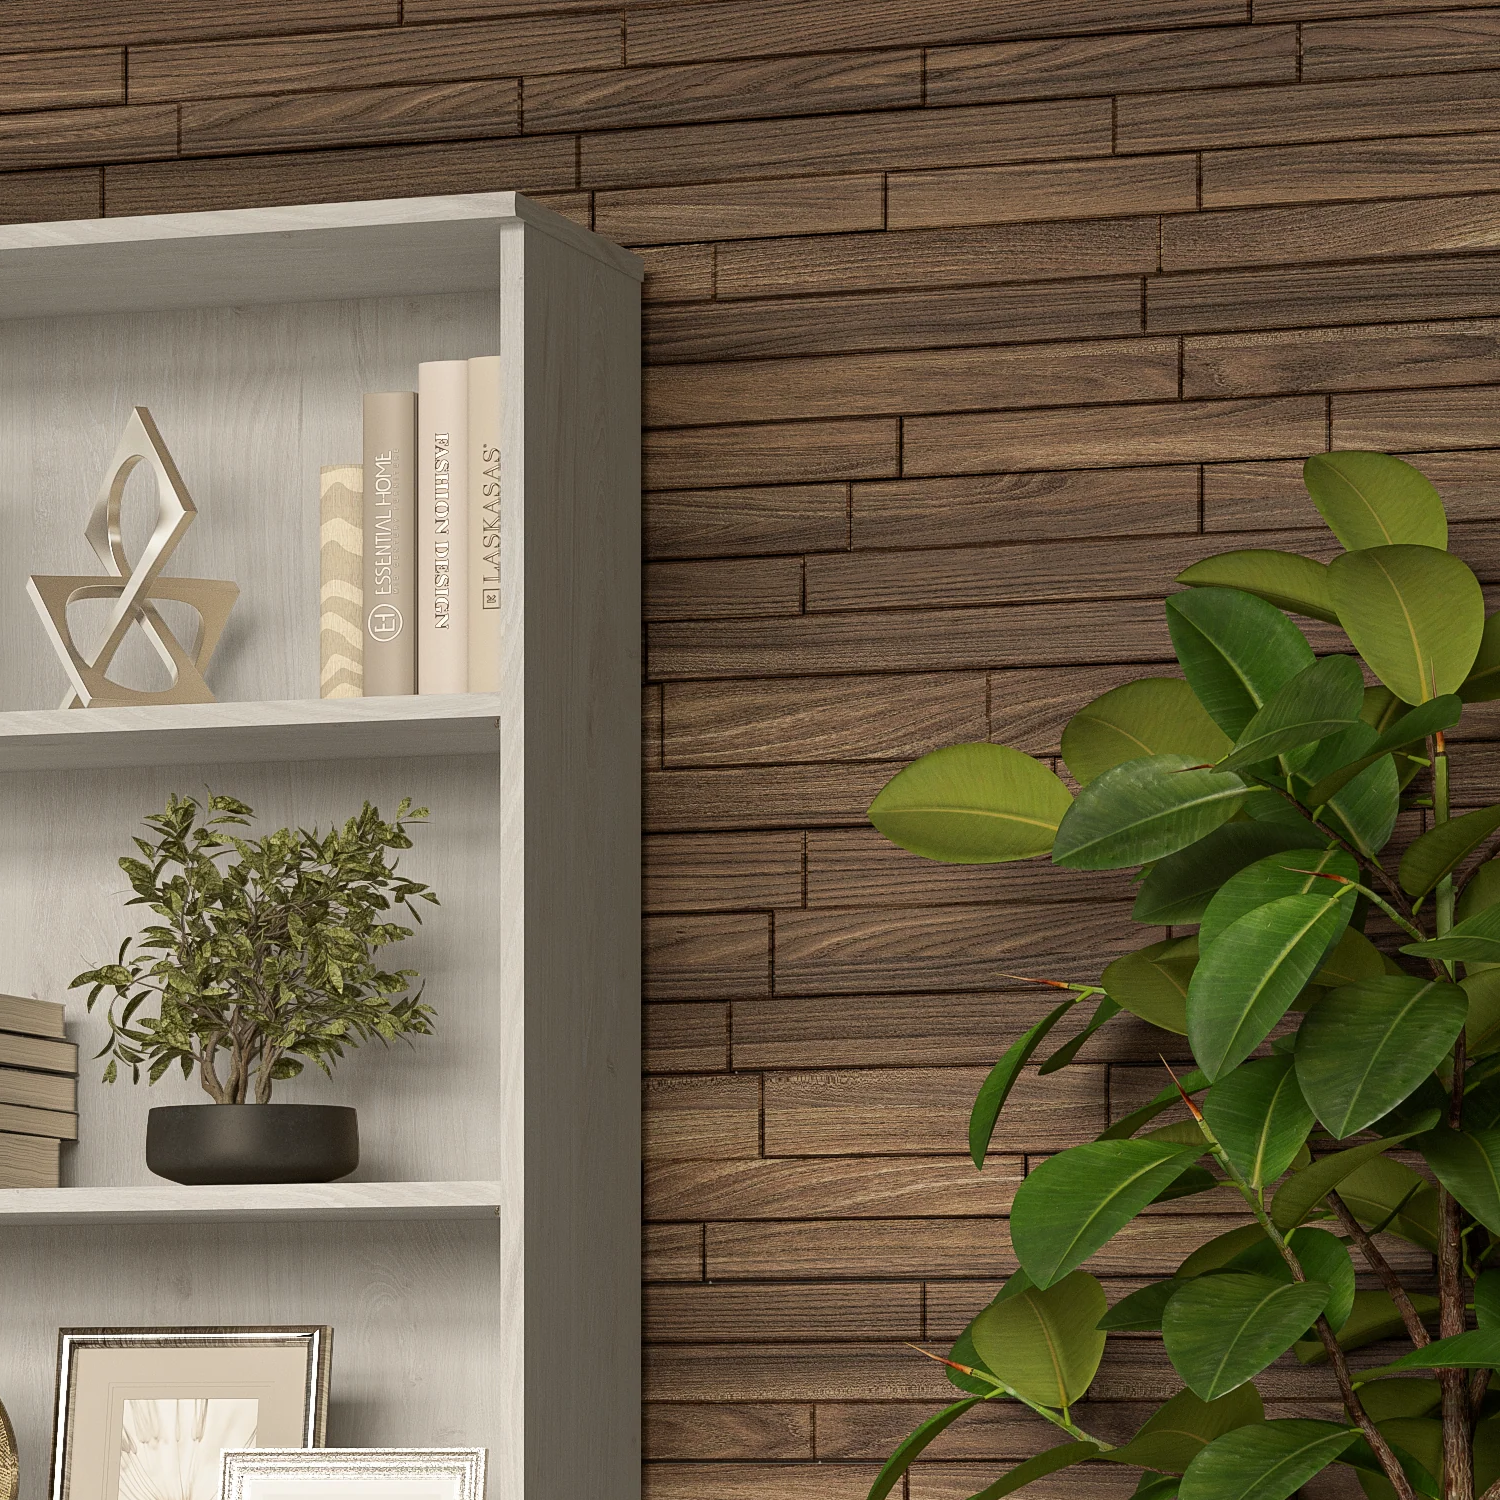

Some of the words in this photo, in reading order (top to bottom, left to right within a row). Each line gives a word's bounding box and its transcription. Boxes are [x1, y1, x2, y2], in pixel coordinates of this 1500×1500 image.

[374, 450, 392, 506] HOME
[434, 433, 450, 535] FASHION
[483, 447, 501, 584] LASKASAS
[374, 509, 392, 595] ESSENTIAL
[434, 541, 450, 630] DESIGN
